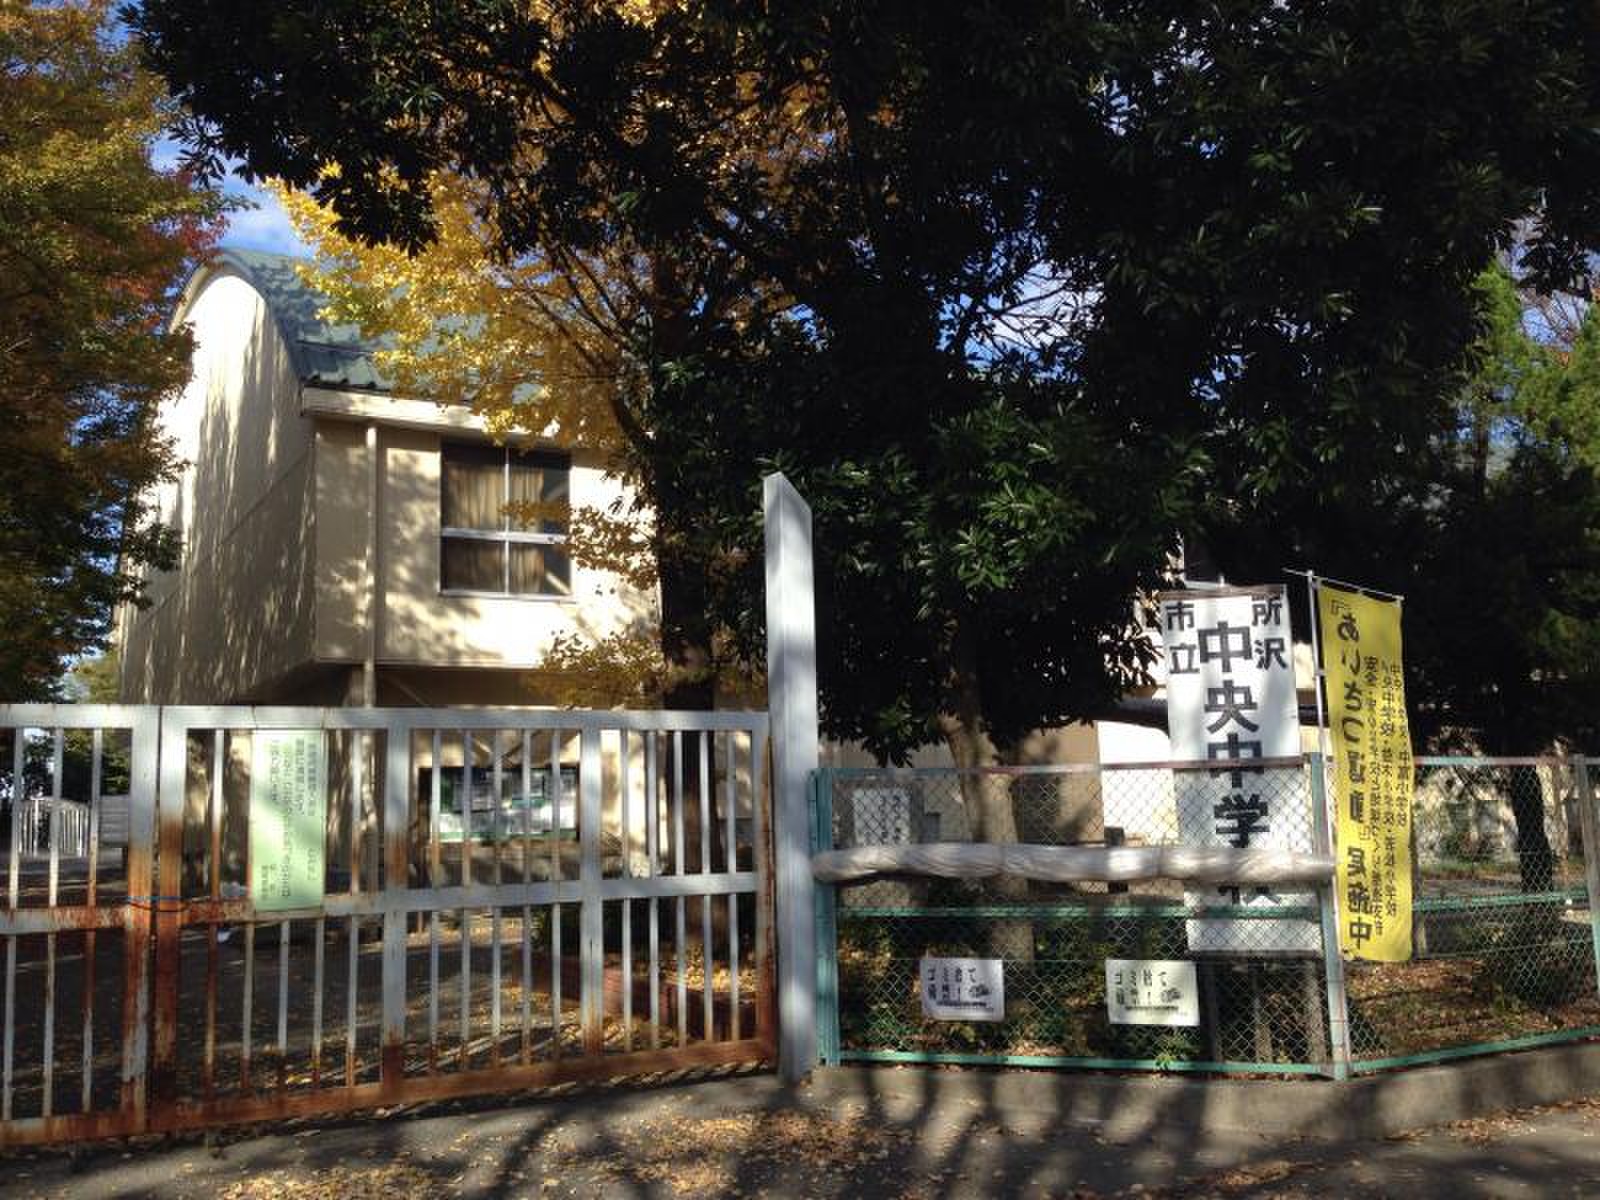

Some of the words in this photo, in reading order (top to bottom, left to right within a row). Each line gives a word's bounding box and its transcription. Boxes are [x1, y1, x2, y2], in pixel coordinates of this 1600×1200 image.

[1165, 602, 1199, 674] 市立
[1251, 597, 1287, 670] 所沢
[1198, 621, 1281, 907] 中央中学
